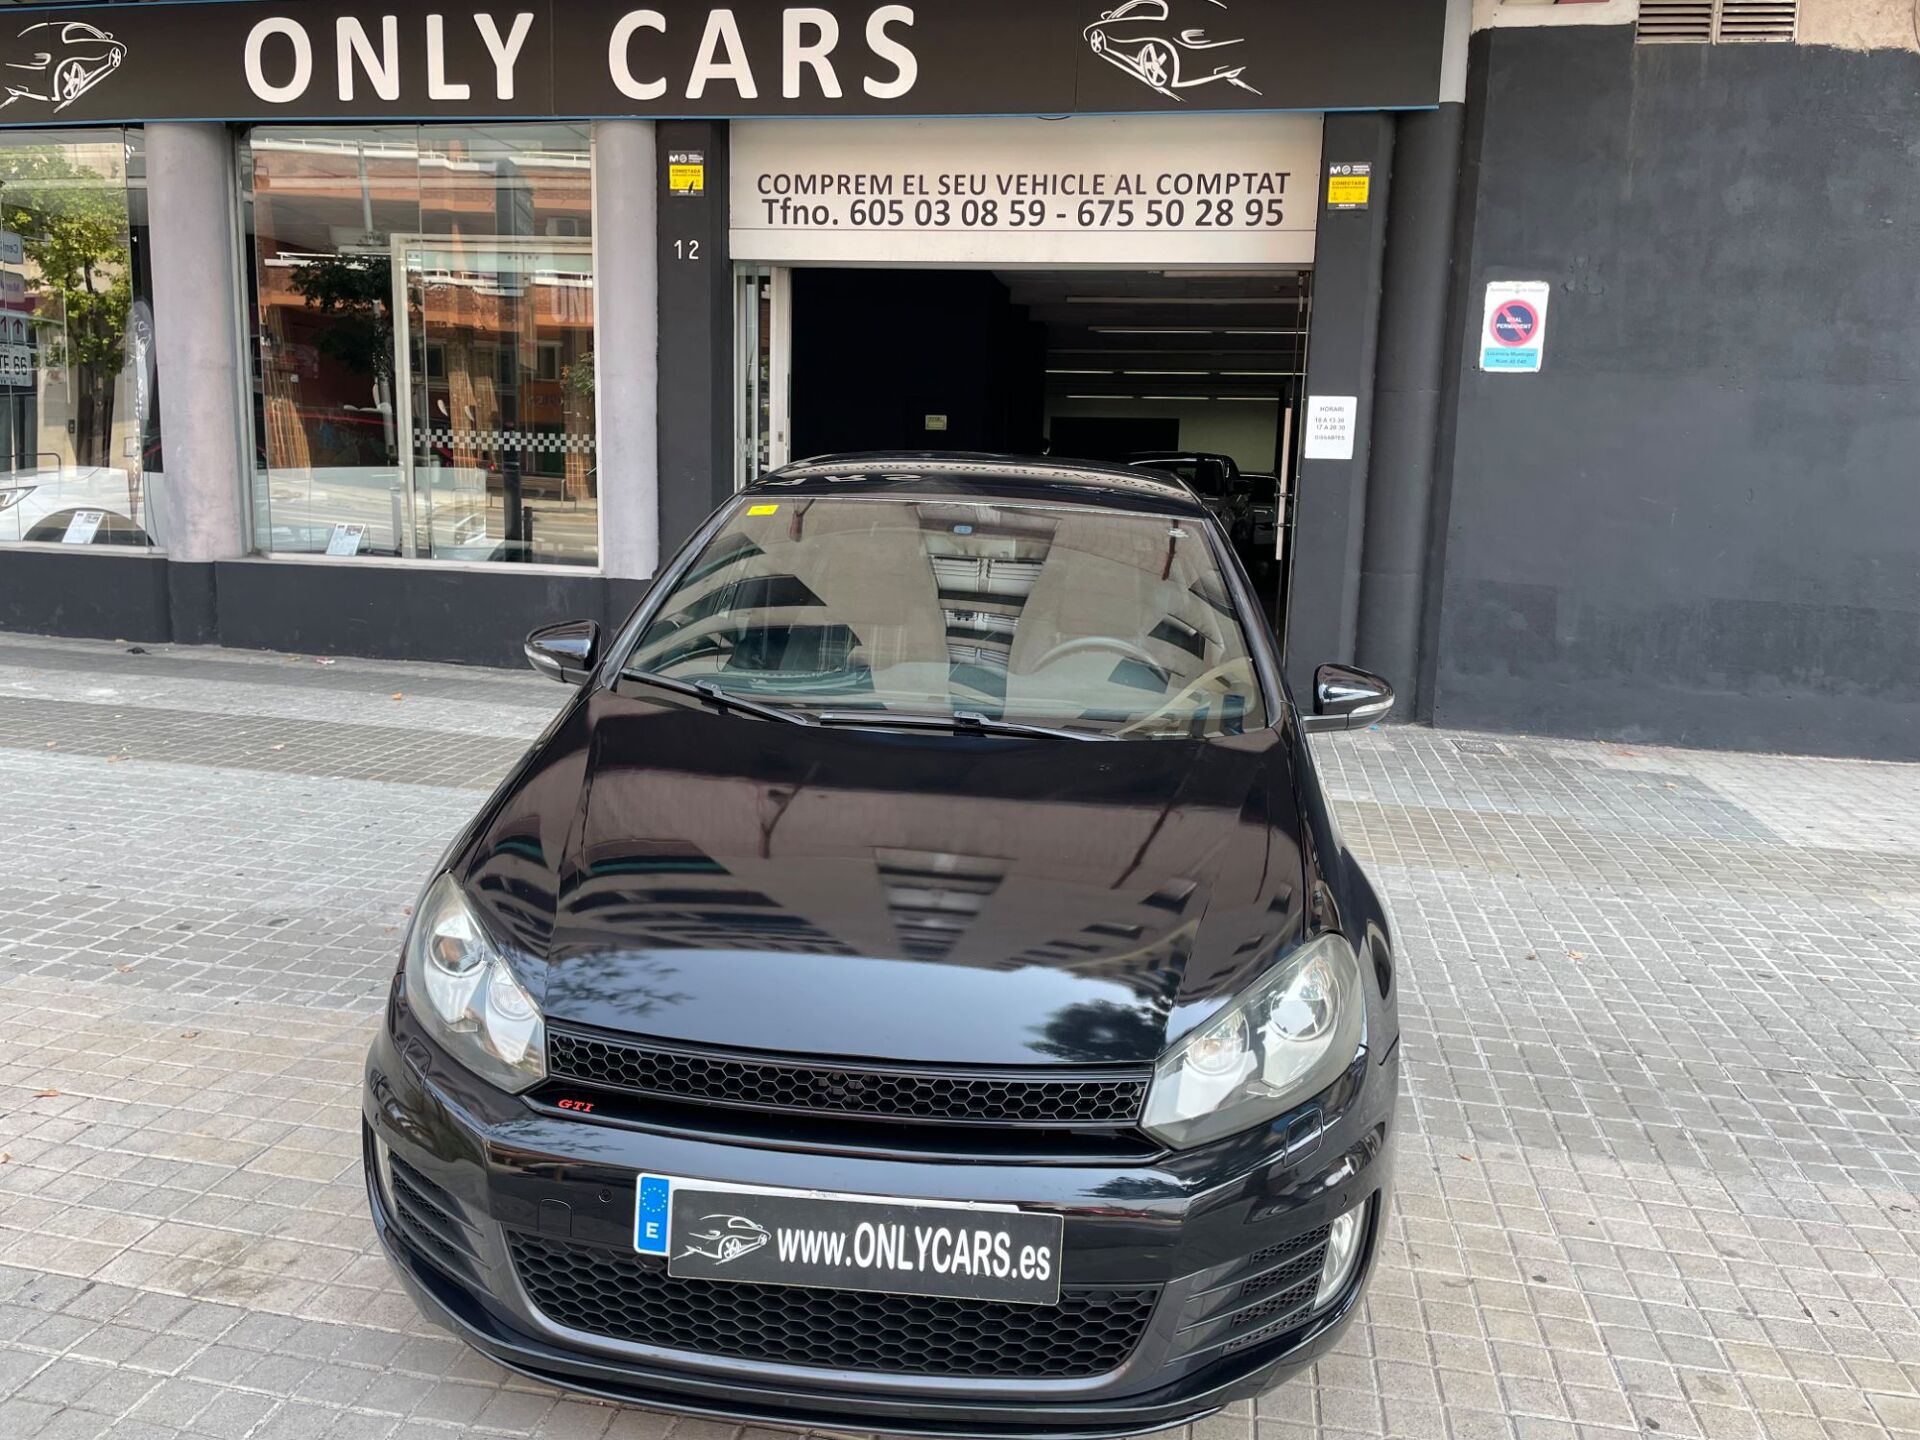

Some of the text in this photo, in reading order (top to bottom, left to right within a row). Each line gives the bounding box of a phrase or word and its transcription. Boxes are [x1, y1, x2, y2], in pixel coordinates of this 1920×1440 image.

[245, 5, 917, 102] ONLY CARS
[758, 172, 1290, 195] COMPREM EL SEU VEHICLE AL COMPTAT
[762, 197, 838, 226] Tfno.
[850, 199, 904, 227] 605
[914, 199, 950, 227] 03
[961, 199, 998, 227] 08
[1009, 199, 1046, 227] 59
[1077, 199, 1134, 227] 675
[1146, 199, 1184, 227] 50
[1195, 198, 1234, 227] 28
[1245, 198, 1283, 227] 95
[673, 239, 699, 260] 12
[14, 355, 27, 375] 66
[558, 1099, 594, 1113] GTI
[646, 1222, 659, 1239] E
[777, 1222, 1050, 1281] www.ONLYCARS.es
